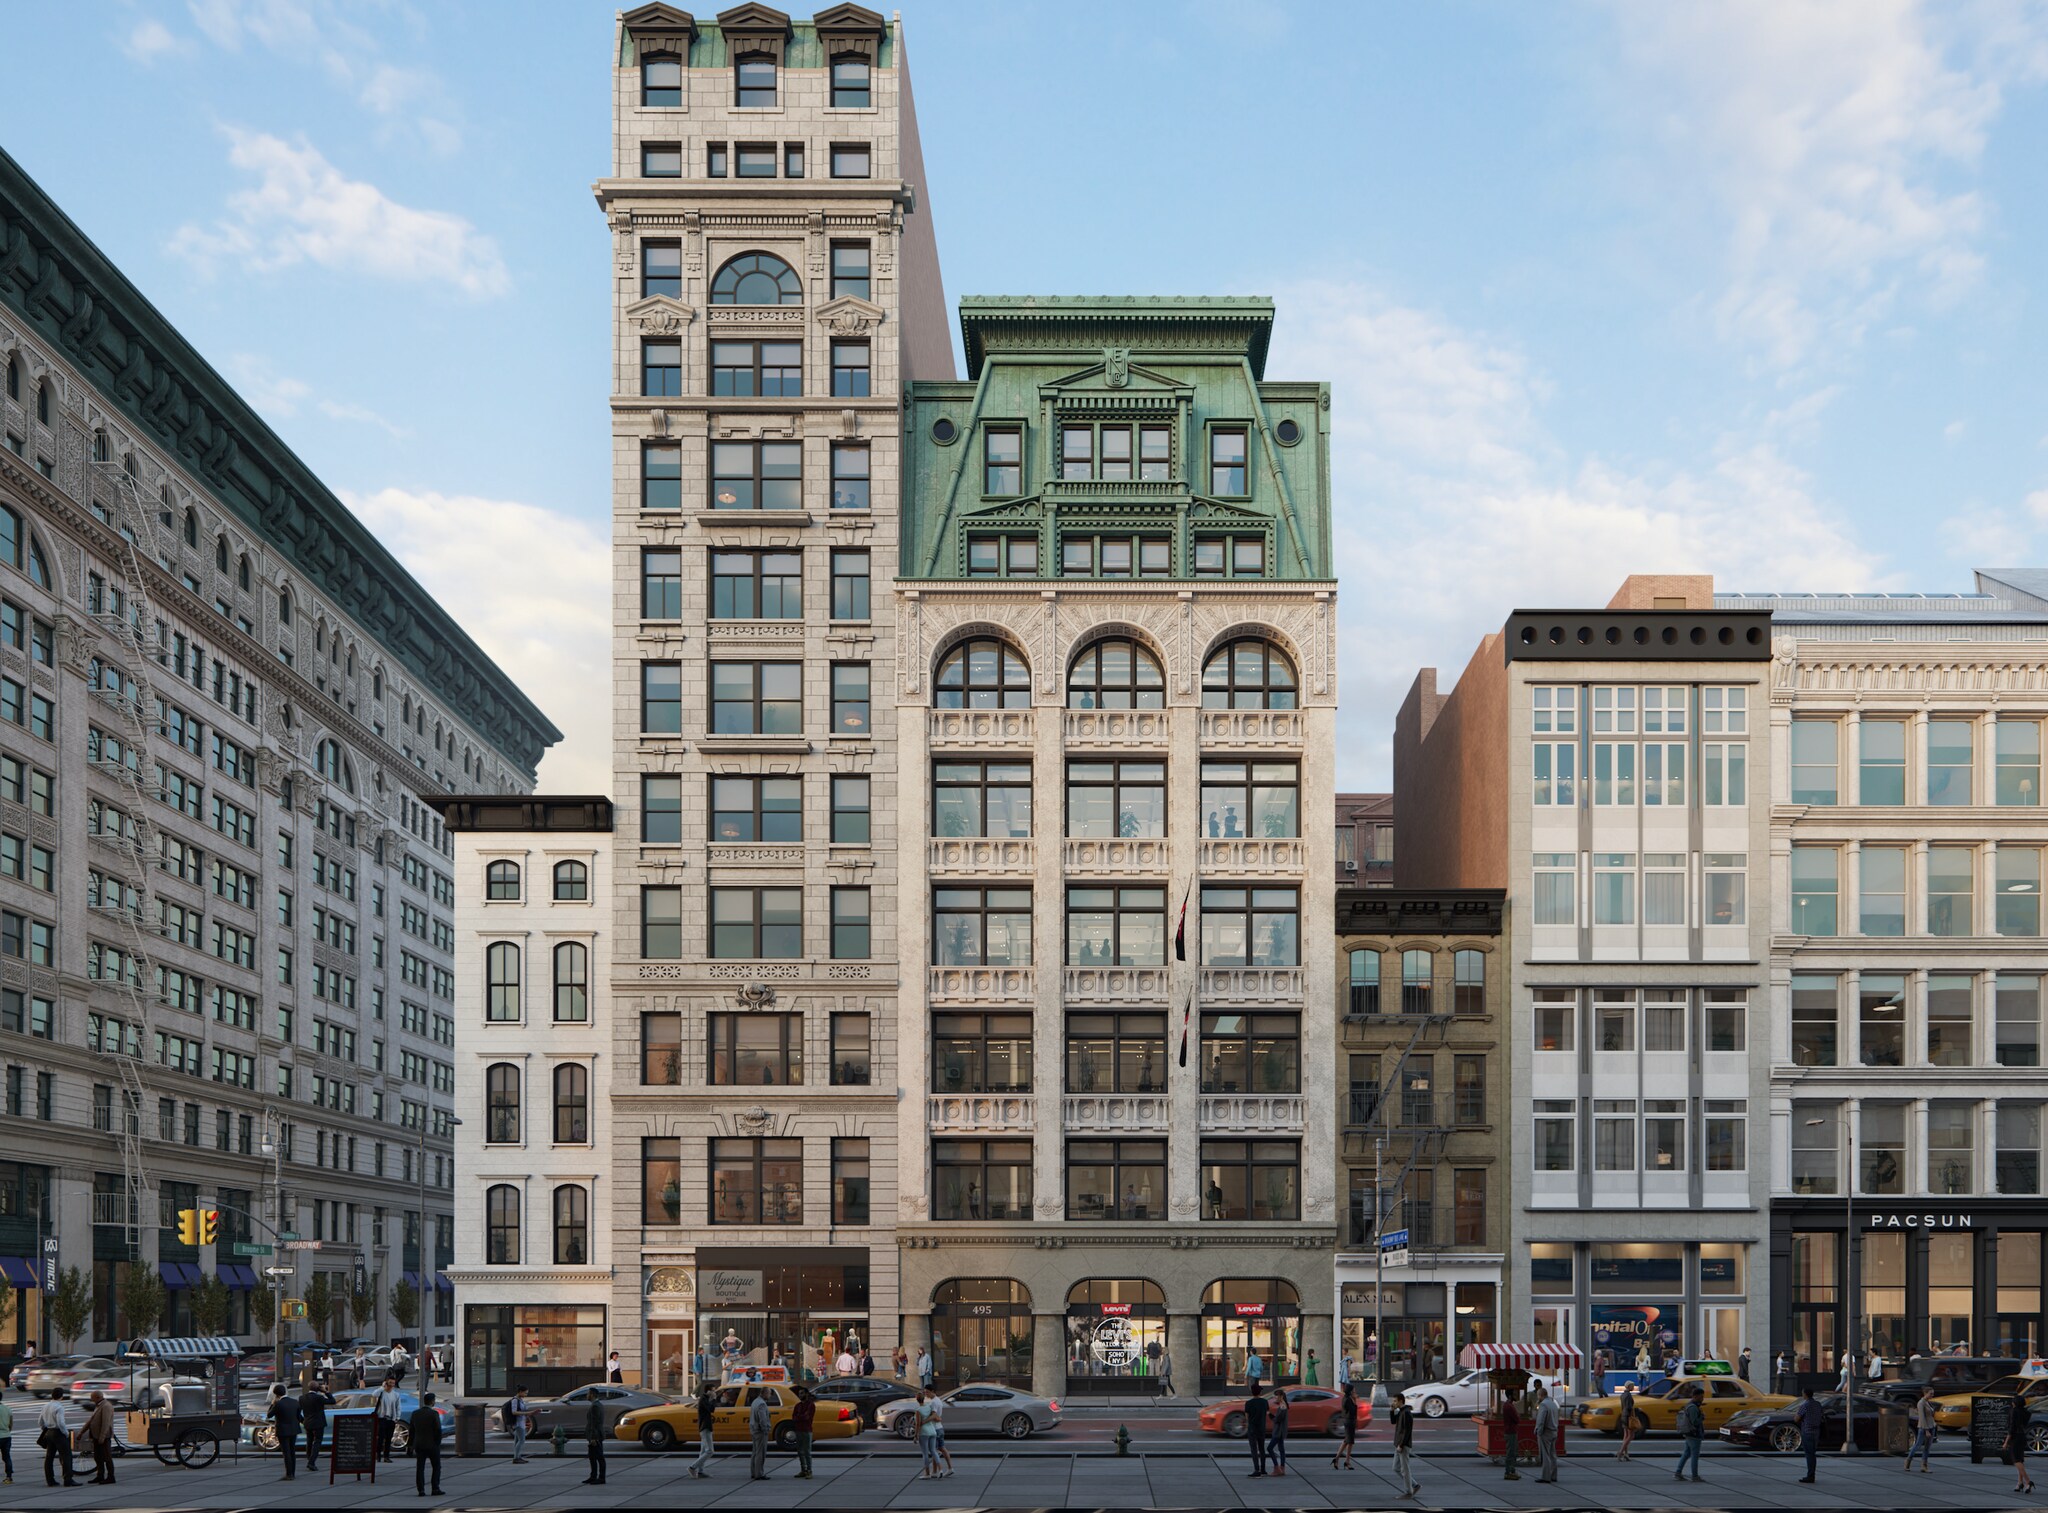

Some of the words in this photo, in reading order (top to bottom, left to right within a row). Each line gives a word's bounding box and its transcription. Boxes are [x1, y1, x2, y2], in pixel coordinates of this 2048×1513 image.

[1871, 1214, 1971, 1227] PACSUN
[286, 1241, 320, 1249] BROADWAY
[707, 1271, 755, 1290] Mystique
[1343, 1294, 1370, 1304] ALEX
[972, 1305, 992, 1315] 495
[304, 1359, 310, 1367] P
